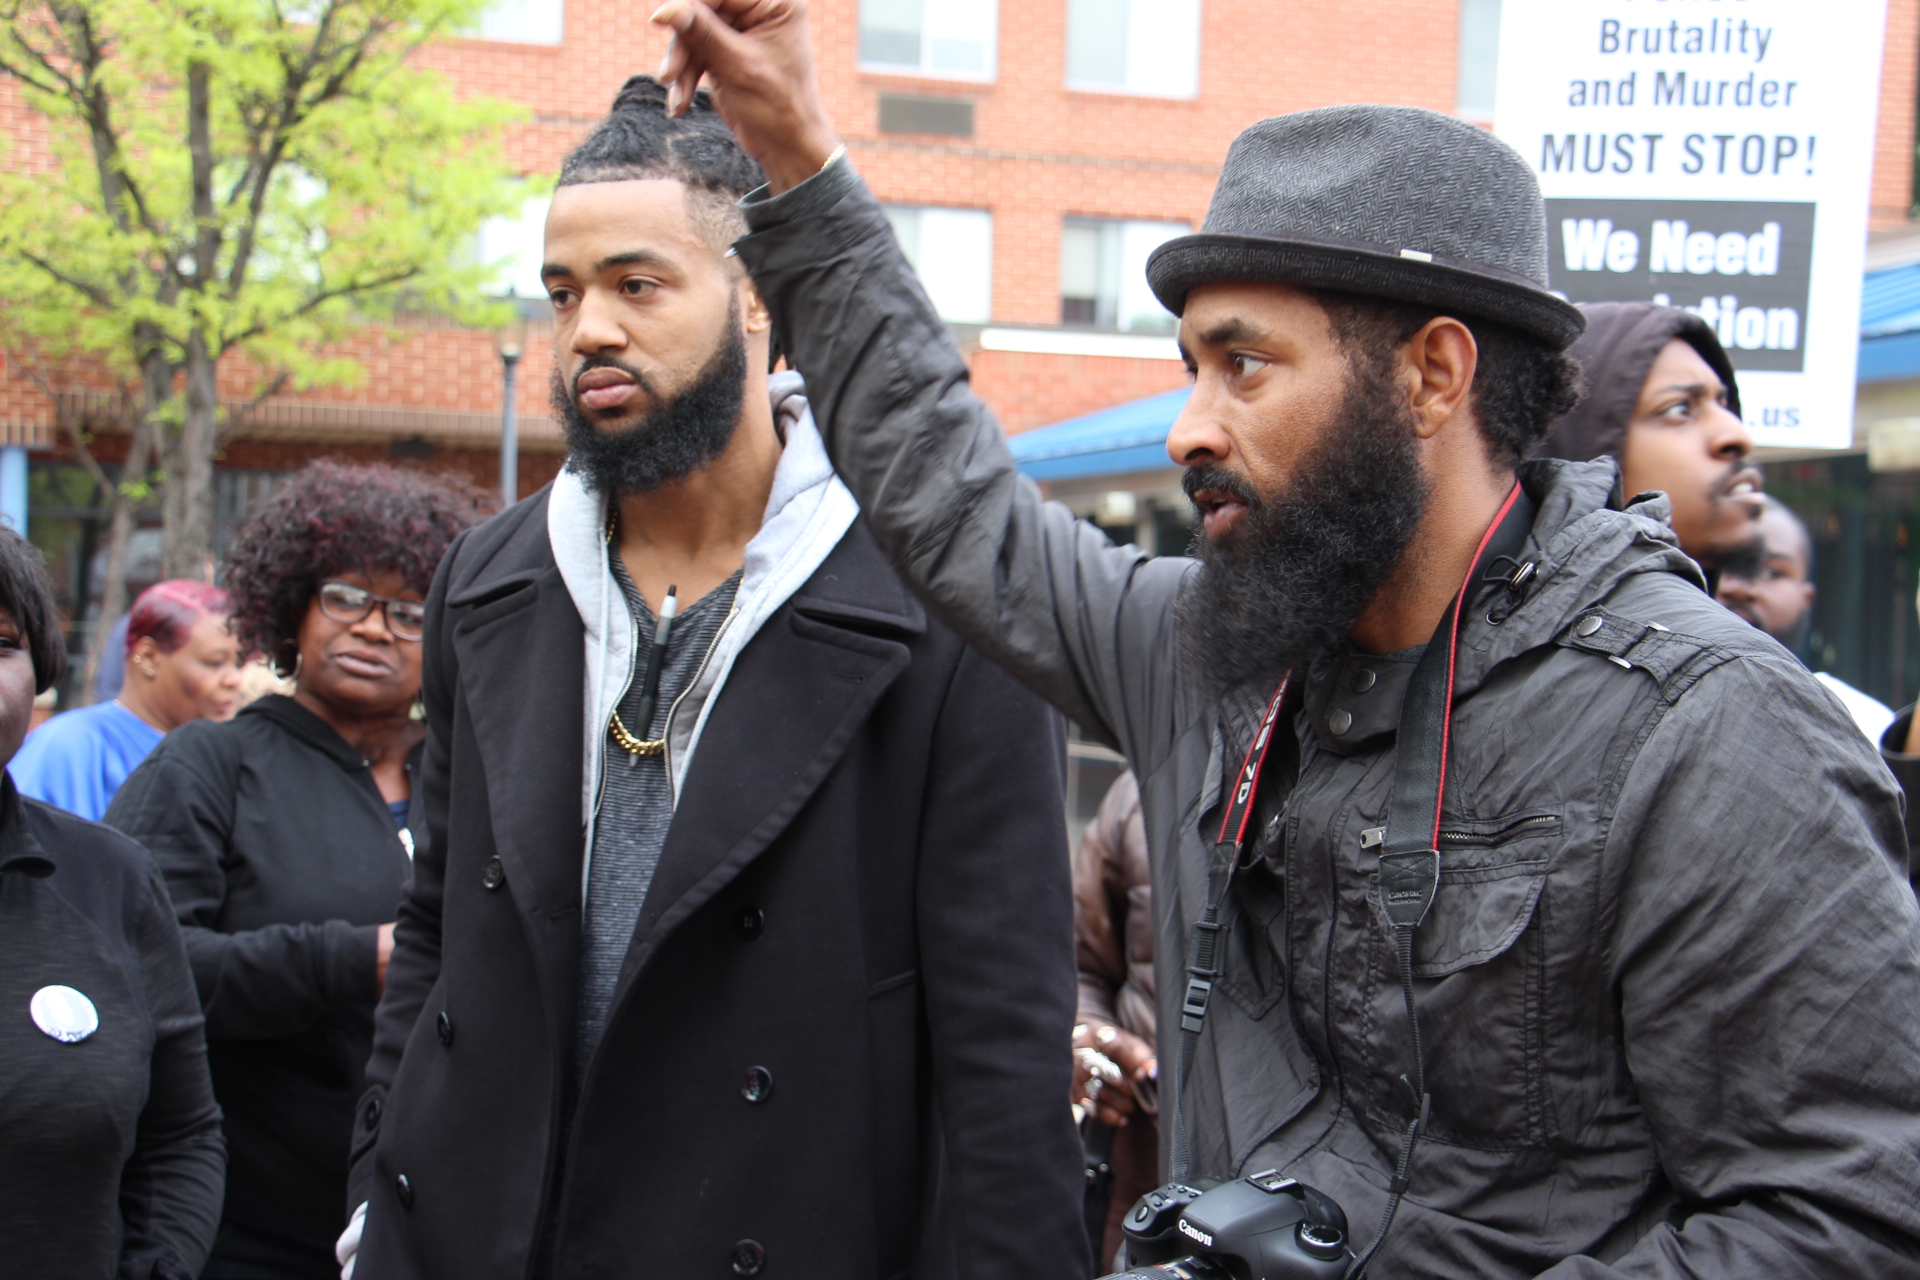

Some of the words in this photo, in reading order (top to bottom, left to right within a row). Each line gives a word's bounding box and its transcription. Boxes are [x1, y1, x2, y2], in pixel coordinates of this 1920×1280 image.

[1599, 18, 1772, 62] Brutality
[1568, 72, 1636, 107] and
[1654, 71, 1797, 107] Murder
[1540, 133, 1664, 174] MUST
[1680, 133, 1817, 176] STOP!
[1561, 218, 1639, 272] We
[1649, 219, 1781, 276] Need
[1179, 1219, 1213, 1246] Canon
